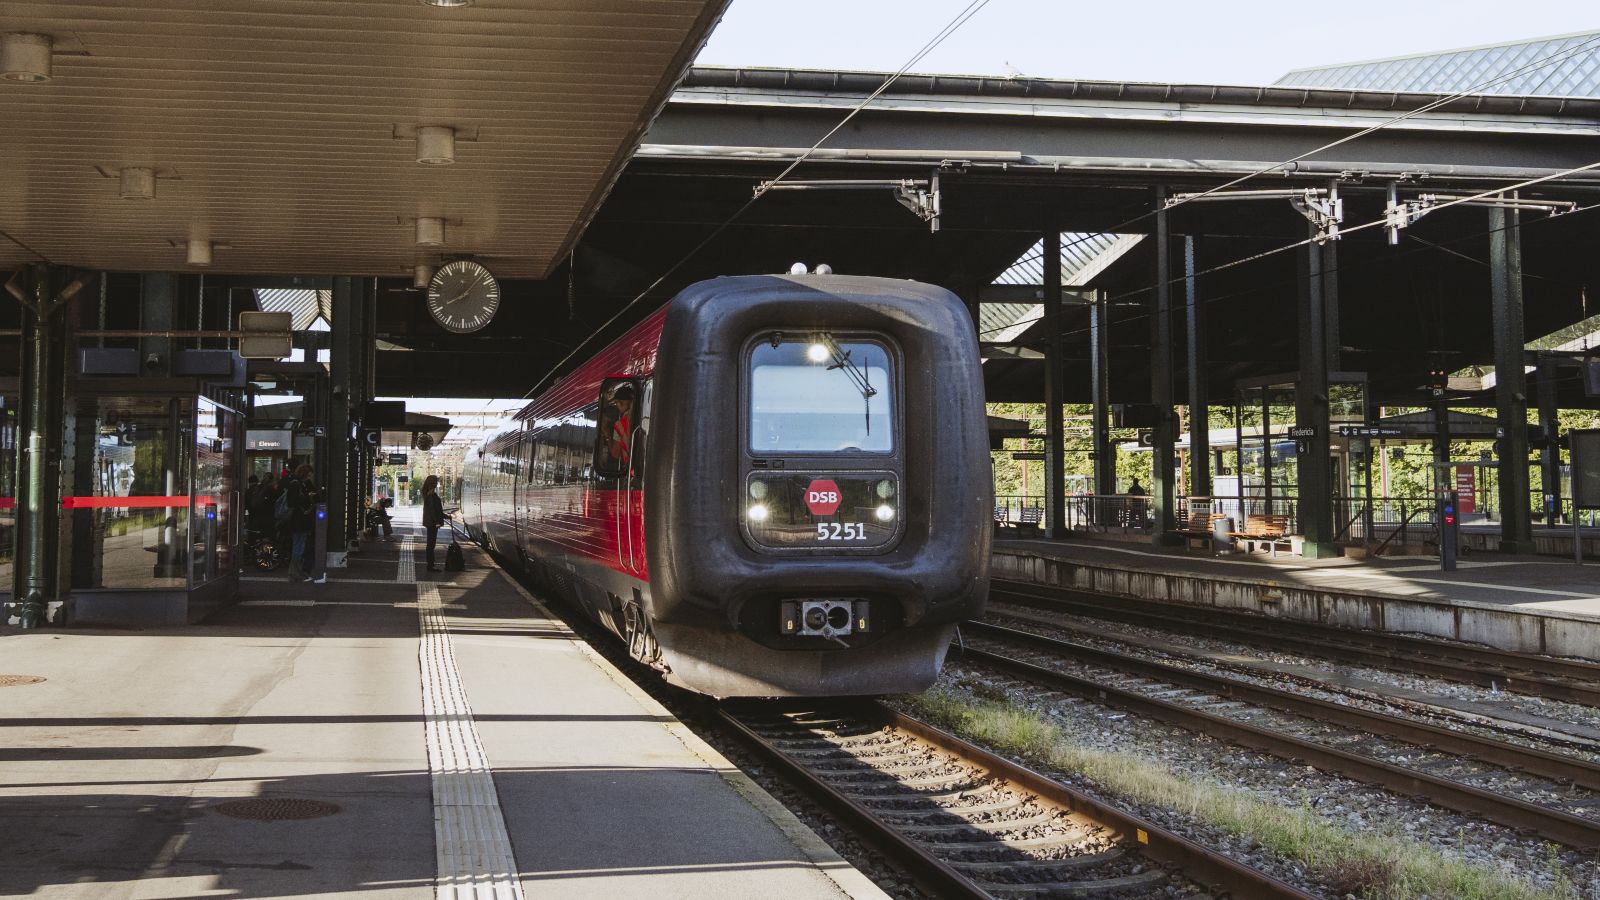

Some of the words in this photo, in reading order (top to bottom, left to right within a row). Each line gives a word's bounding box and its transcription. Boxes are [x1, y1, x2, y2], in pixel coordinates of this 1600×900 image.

[367, 431, 377, 444] C
[1291, 427, 1314, 437] Fredericia
[1143, 433, 1151, 445] C
[809, 492, 838, 503] DSB
[817, 522, 867, 541] 5251
